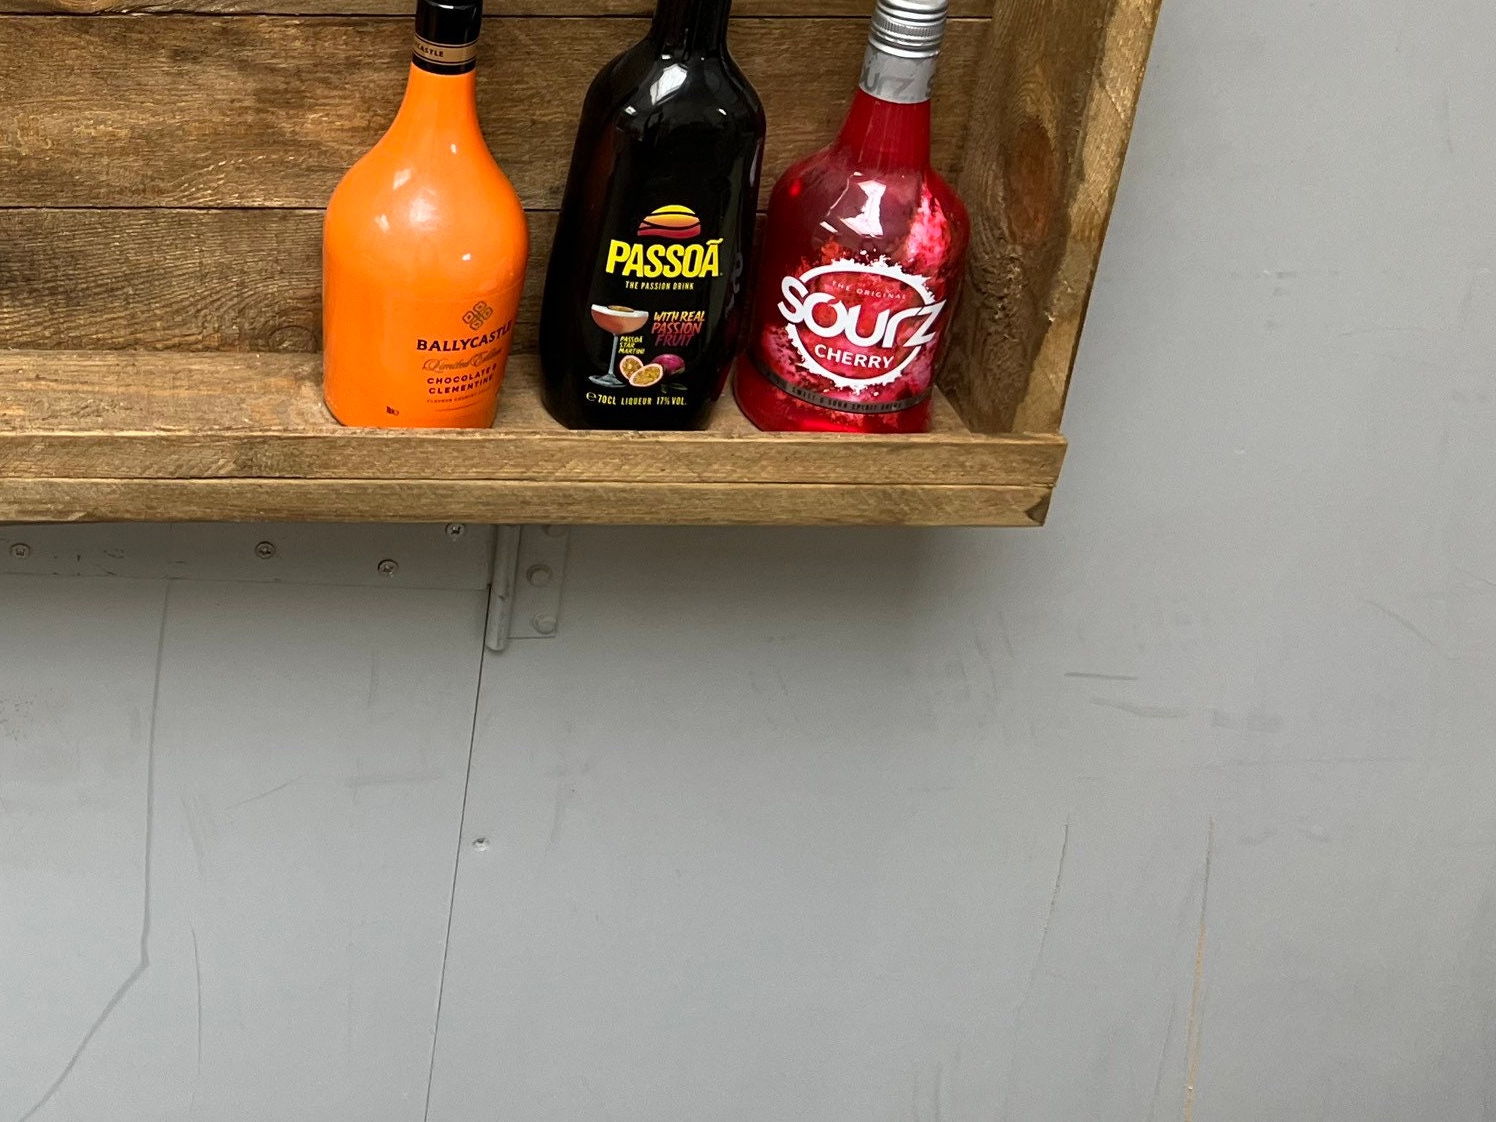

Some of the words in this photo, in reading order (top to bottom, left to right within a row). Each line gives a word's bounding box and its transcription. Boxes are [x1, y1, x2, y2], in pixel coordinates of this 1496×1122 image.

[605, 238, 723, 278] PASSOÃ
[625, 280, 638, 290] THE
[640, 282, 672, 290] PASSION
[673, 282, 694, 290] DRINK
[831, 280, 852, 292] THE
[856, 288, 907, 300] ORIGINAL
[653, 311, 680, 322] WITH
[680, 311, 705, 322] REAL
[416, 319, 513, 352] BALLYCASTLE
[650, 322, 702, 334] PASSION
[655, 333, 695, 347] FRUIT
[814, 343, 895, 369] CHERRY
[427, 366, 491, 385] CHOCOLATE
[428, 374, 493, 394] CLEMENTINE
[597, 393, 616, 405] 70CL
[620, 396, 652, 406] LIQUEUR
[656, 396, 670, 406] 17%
[671, 396, 687, 406] VOL.
[827, 399, 848, 410] SOUR
